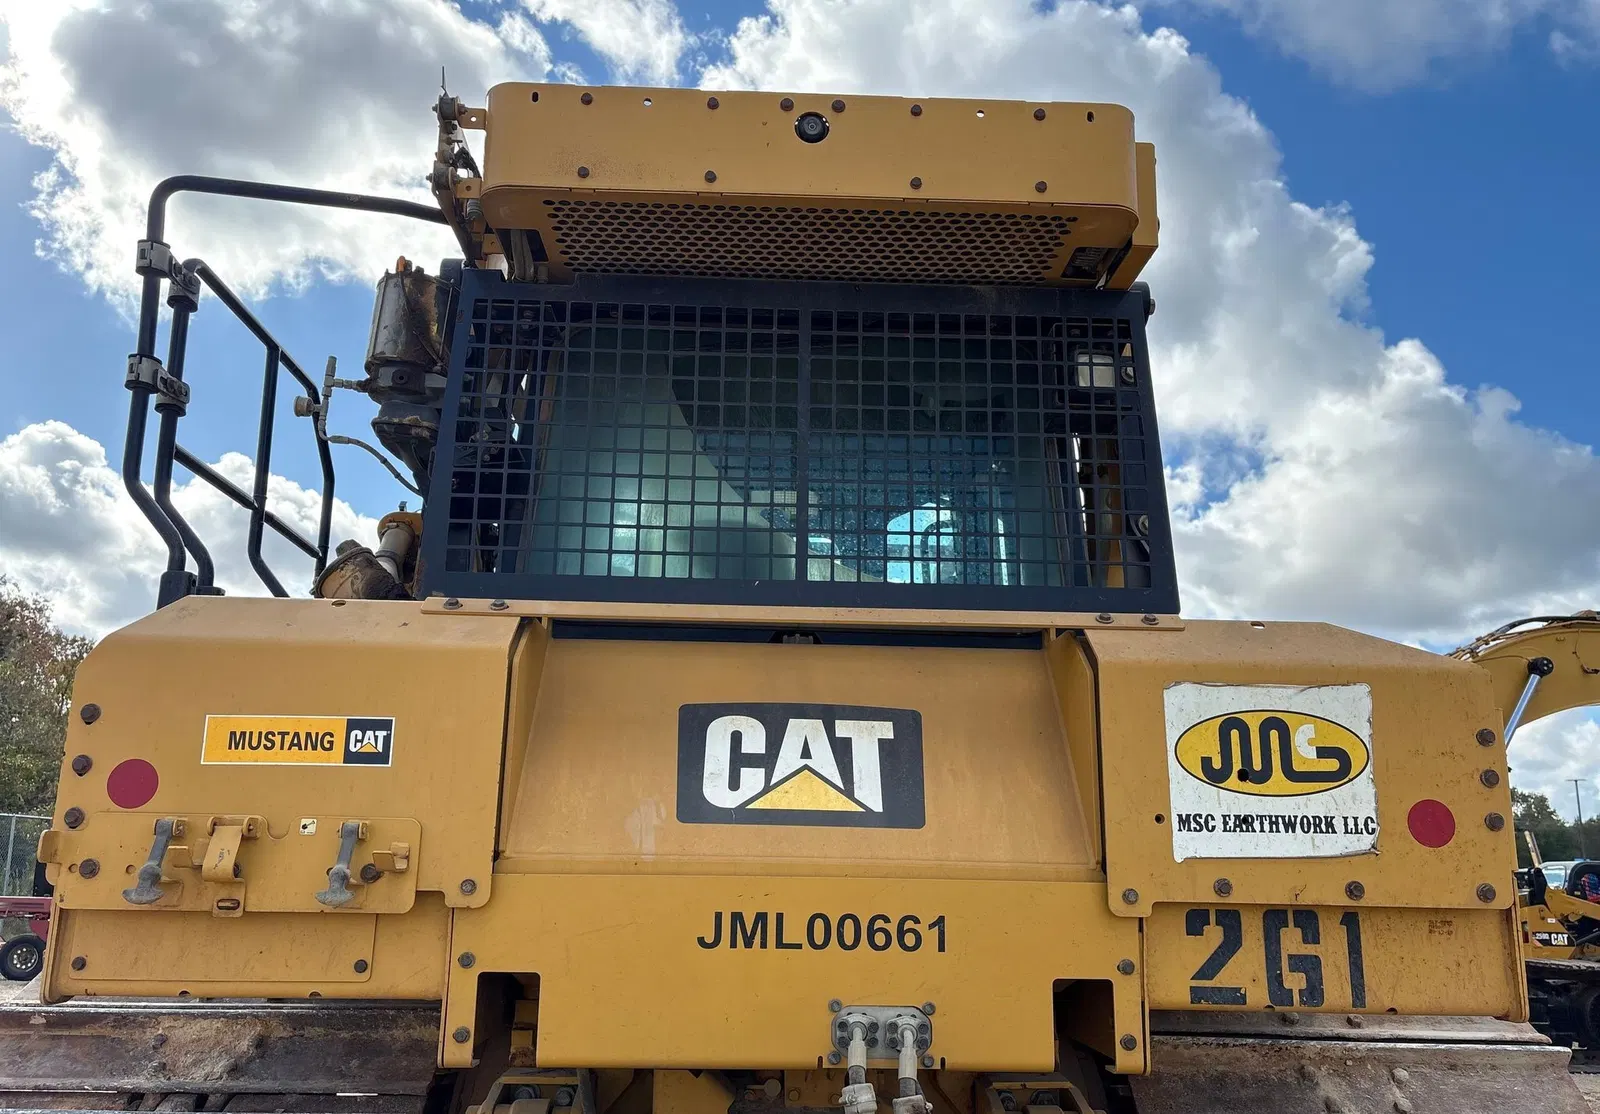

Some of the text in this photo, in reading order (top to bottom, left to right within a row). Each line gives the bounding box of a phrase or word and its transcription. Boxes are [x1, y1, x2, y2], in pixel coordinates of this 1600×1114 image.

[227, 729, 388, 753] MUSTANG CAT
[702, 715, 895, 813] CAT
[1177, 813, 1378, 837] MSC EARTHWORK LLC
[696, 911, 947, 953] JML00661
[1551, 933, 1569, 946] CAT
